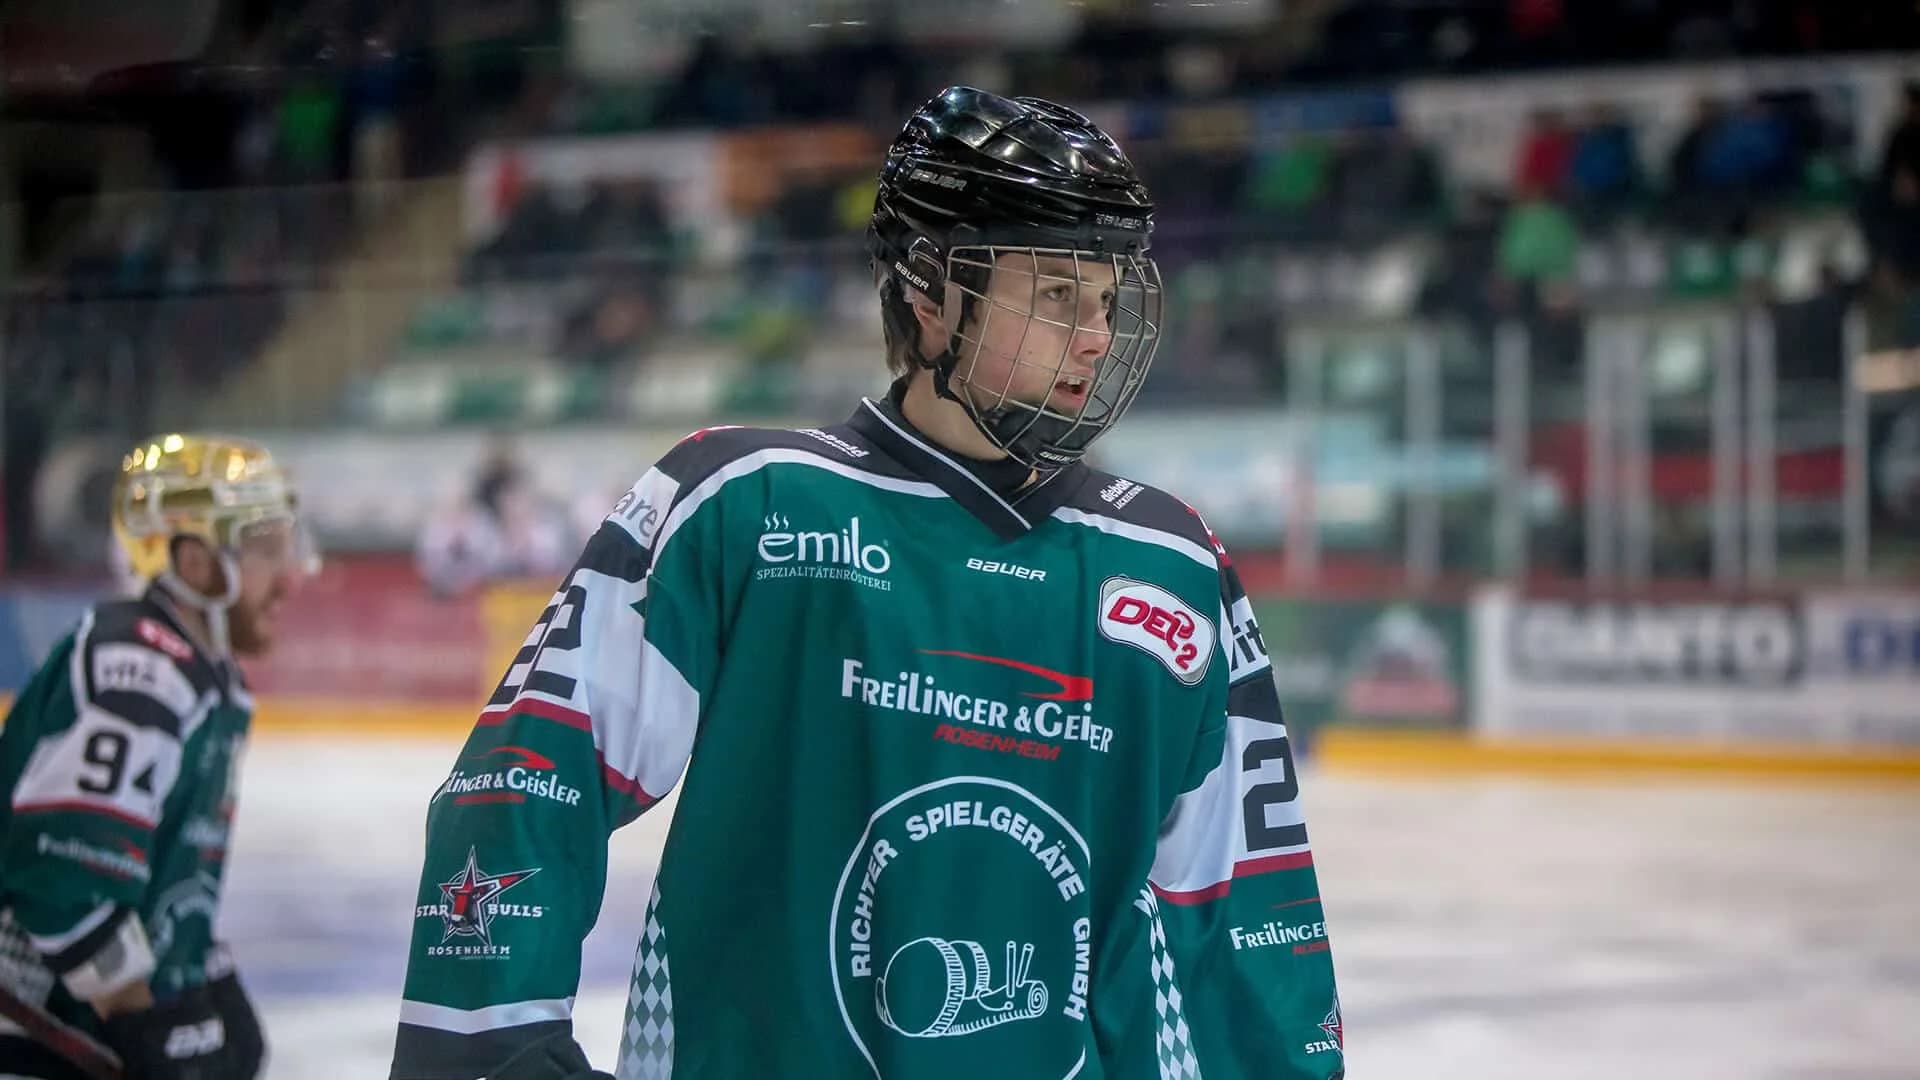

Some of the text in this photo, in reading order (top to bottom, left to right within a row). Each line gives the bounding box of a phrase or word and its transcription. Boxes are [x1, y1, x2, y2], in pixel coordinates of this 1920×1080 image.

[895, 261, 929, 290] BAUER
[758, 516, 891, 574] emilo
[757, 565, 891, 591] SPEZIALITÄTENRÖSTEREI
[966, 557, 1047, 582] BAUER
[841, 658, 1009, 729] FREILINGER
[933, 724, 1061, 761] ROSENHEIM
[505, 767, 581, 806] GEISLER
[1243, 736, 1308, 852] 2
[416, 903, 543, 918] STAR BULLS
[851, 800, 1090, 1022] RICHTER SPIELGERÄTE GMBH
[427, 945, 511, 956] ROSENHEIM
[1305, 1040, 1340, 1054] STAR
